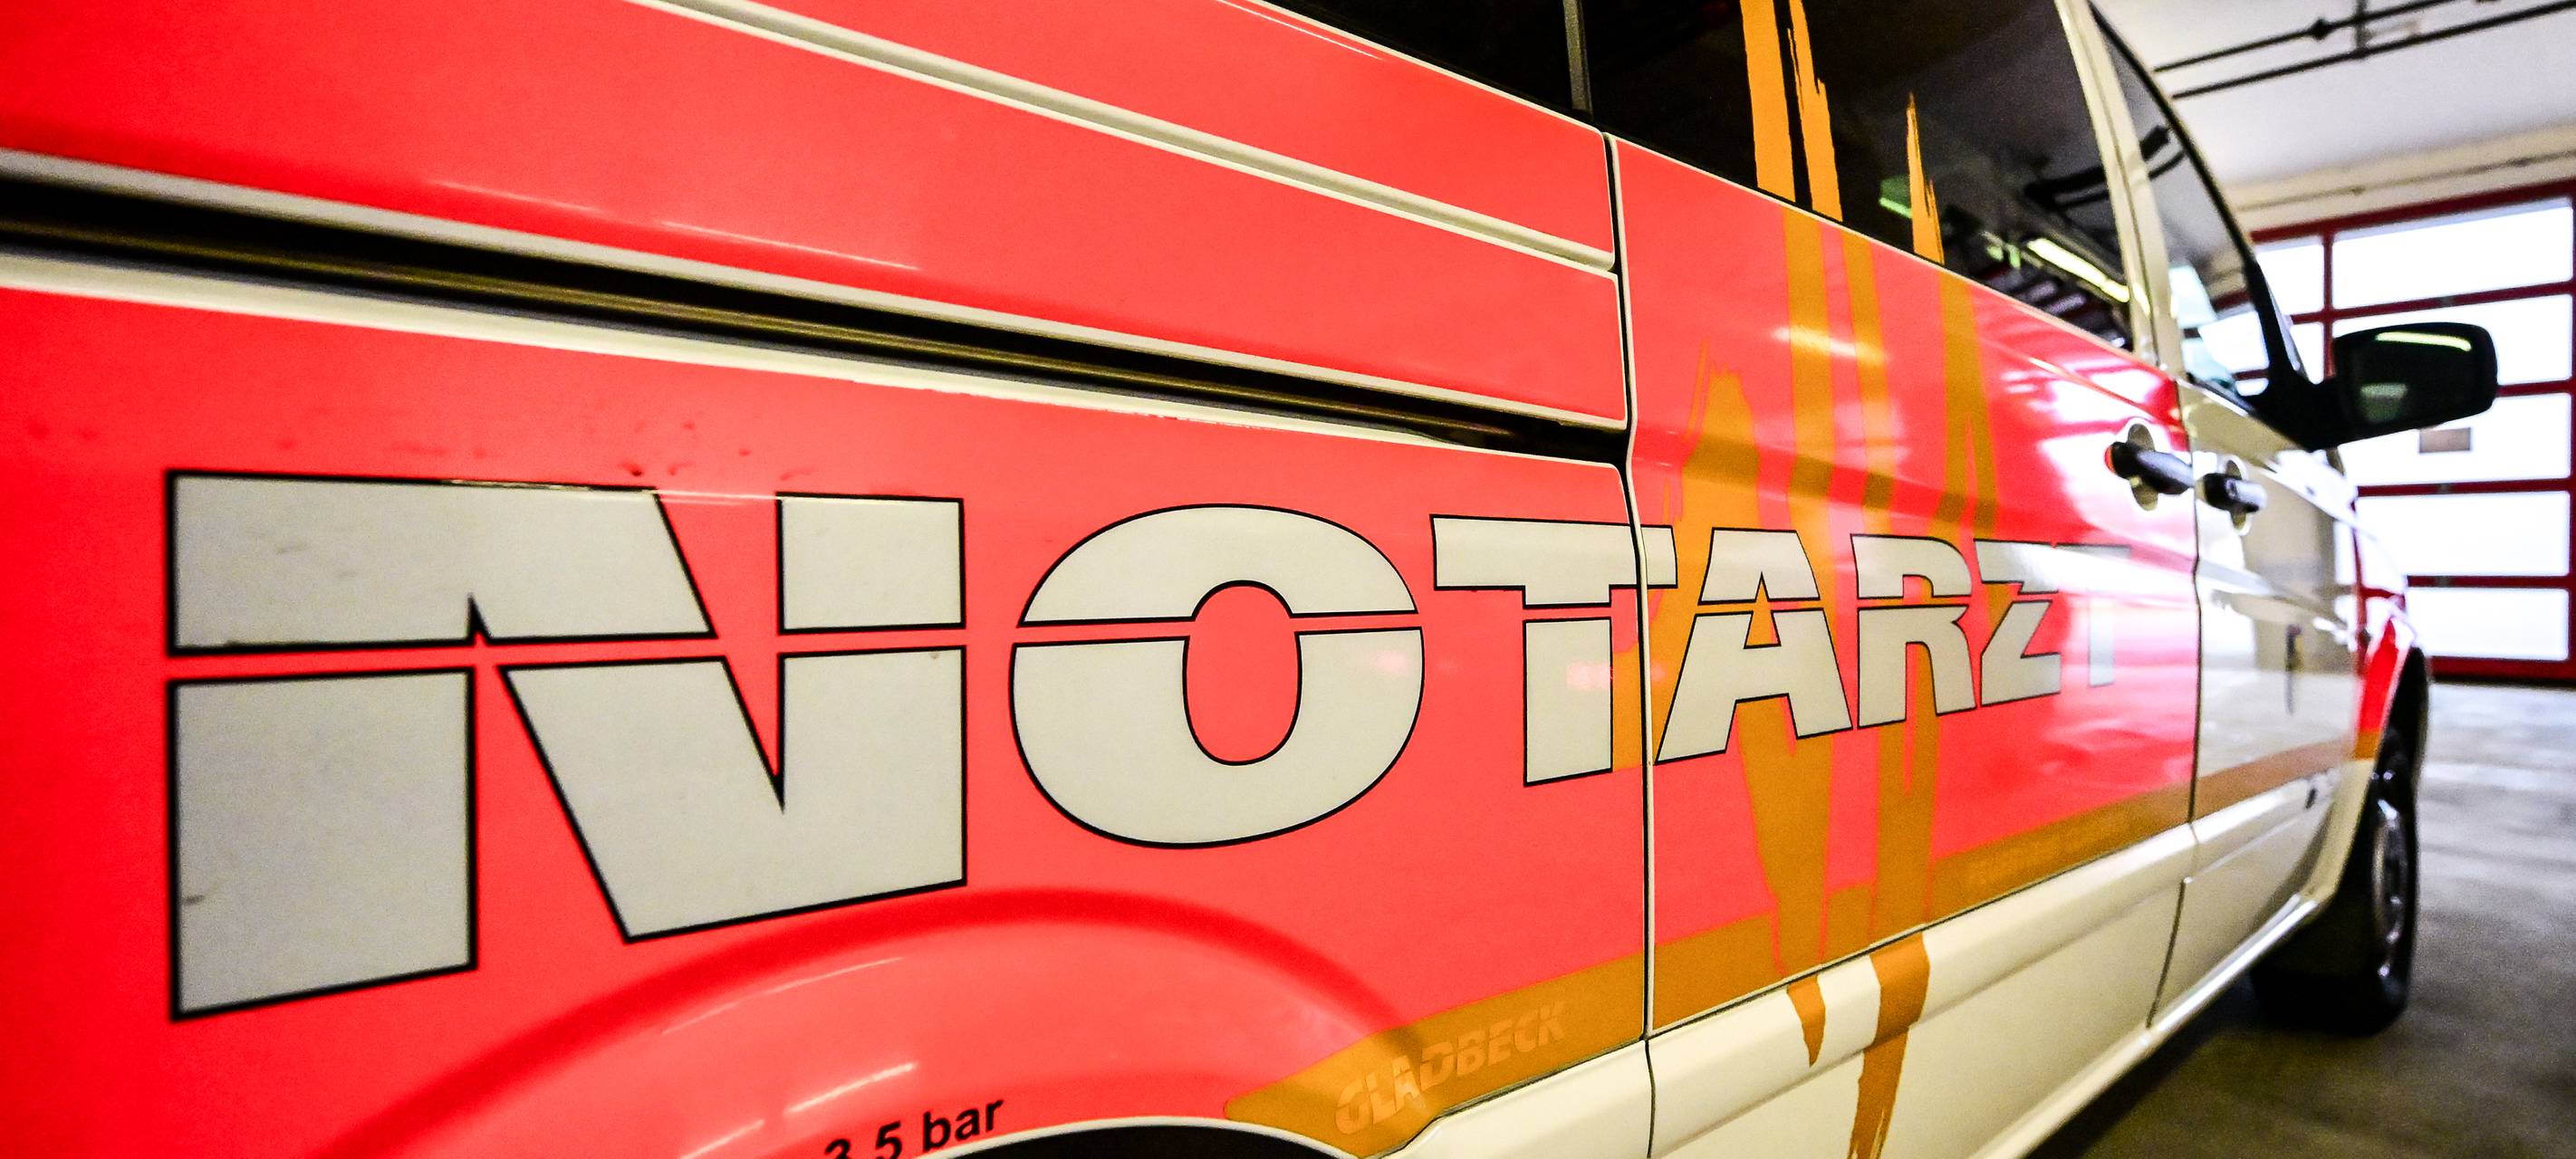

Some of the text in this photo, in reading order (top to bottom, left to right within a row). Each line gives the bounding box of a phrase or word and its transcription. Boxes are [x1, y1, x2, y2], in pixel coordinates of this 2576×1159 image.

[168, 470, 2131, 1021] NOTARZT
[922, 1099, 1004, 1151] bar
[1334, 1002, 1567, 1135] GLADBECK
